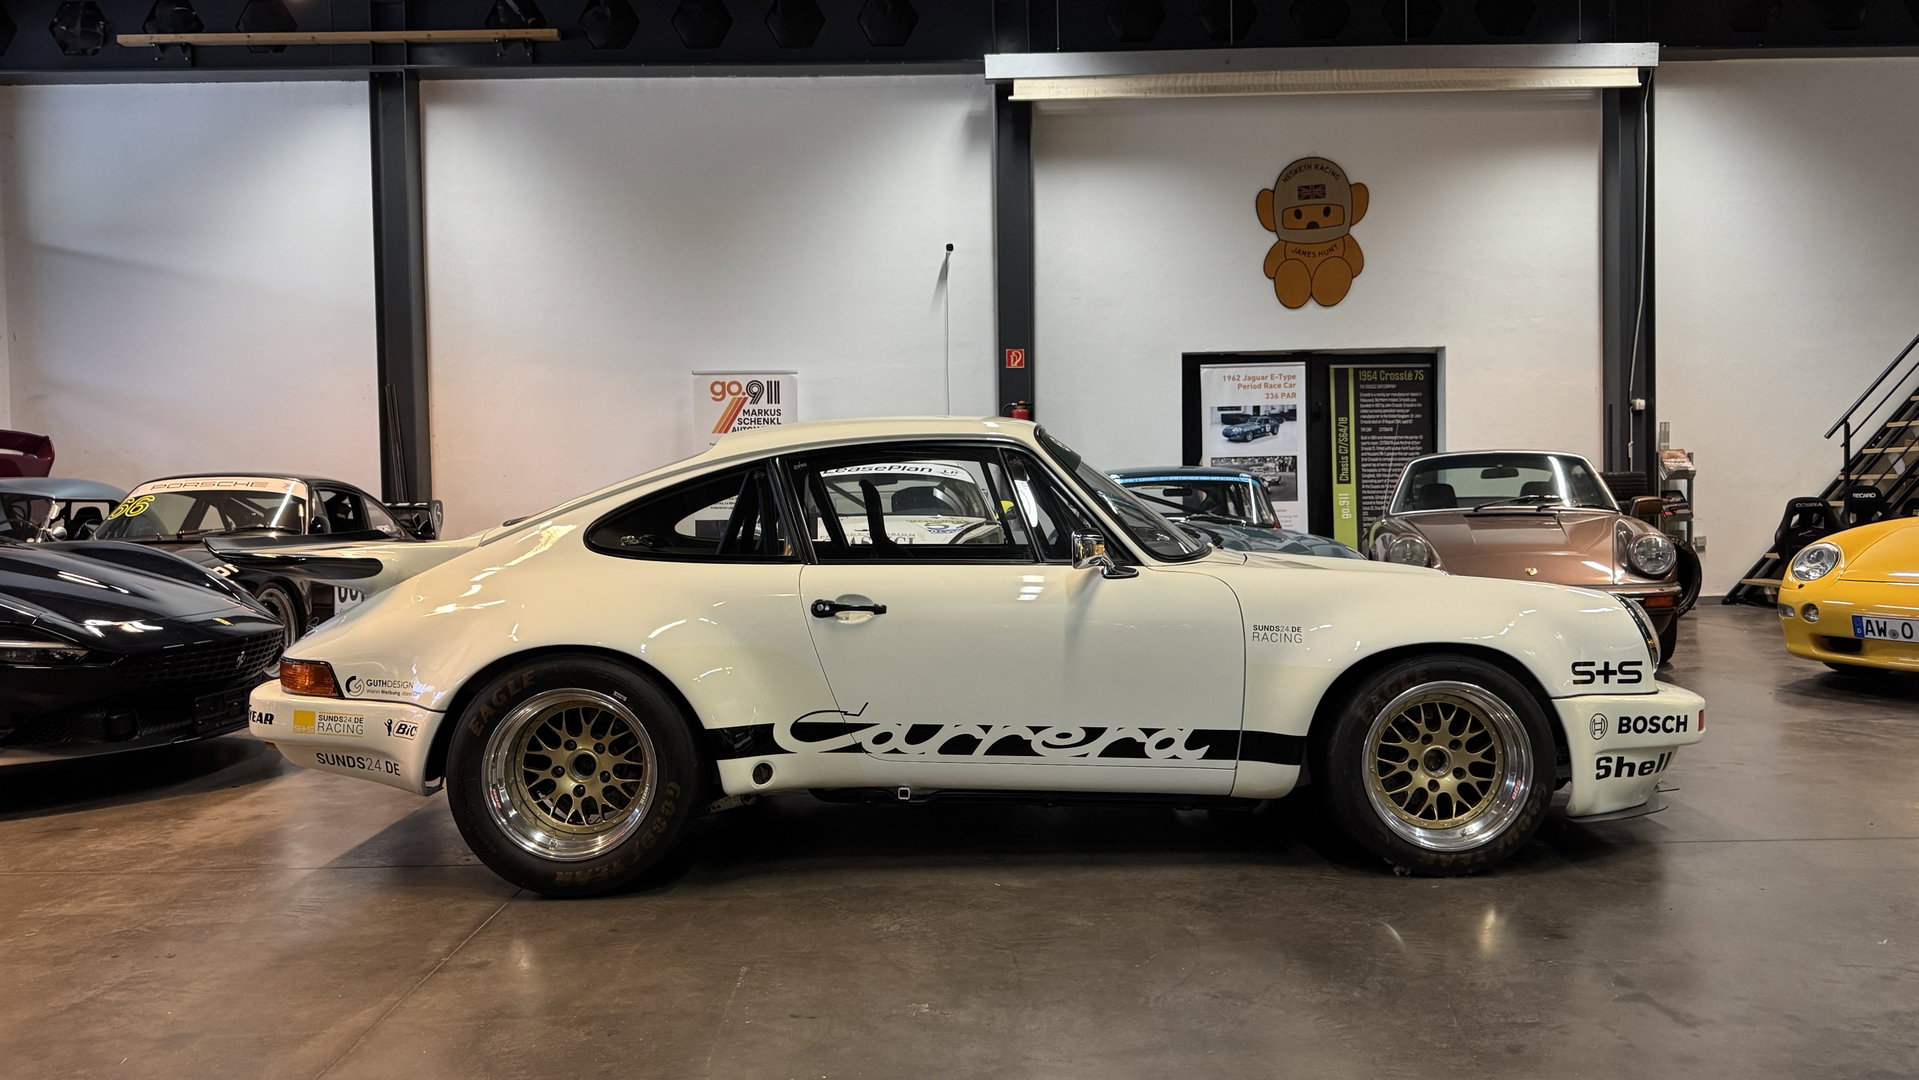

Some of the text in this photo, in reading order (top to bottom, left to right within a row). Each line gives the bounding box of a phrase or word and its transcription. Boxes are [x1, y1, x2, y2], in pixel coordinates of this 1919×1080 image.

[1282, 163, 1341, 184] HESKETH RACING
[1291, 243, 1339, 259] JAMES HUNT
[1223, 372, 1297, 384] 1962 Jaguar E-Type
[1359, 370, 1378, 381] 1964
[1237, 381, 1297, 390] Period Race Car
[1265, 392, 1297, 400] 336 PAR
[742, 408, 782, 417] MARKUS
[737, 417, 782, 426] SCHENKL
[1339, 455, 1350, 482] Chasis
[150, 481, 269, 491] PORSCHE
[1338, 493, 1352, 519] go.911
[1864, 619, 1887, 638] AW
[1252, 632, 1303, 644] RACING
[1571, 660, 1643, 685] S+S
[468, 668, 537, 737] EAGLE
[317, 722, 364, 735] RACING
[773, 702, 1212, 758] Carrera
[1617, 714, 1689, 735] BOSCH
[316, 752, 401, 777] SUNDS24.DE
[1595, 751, 1673, 781] Shell
